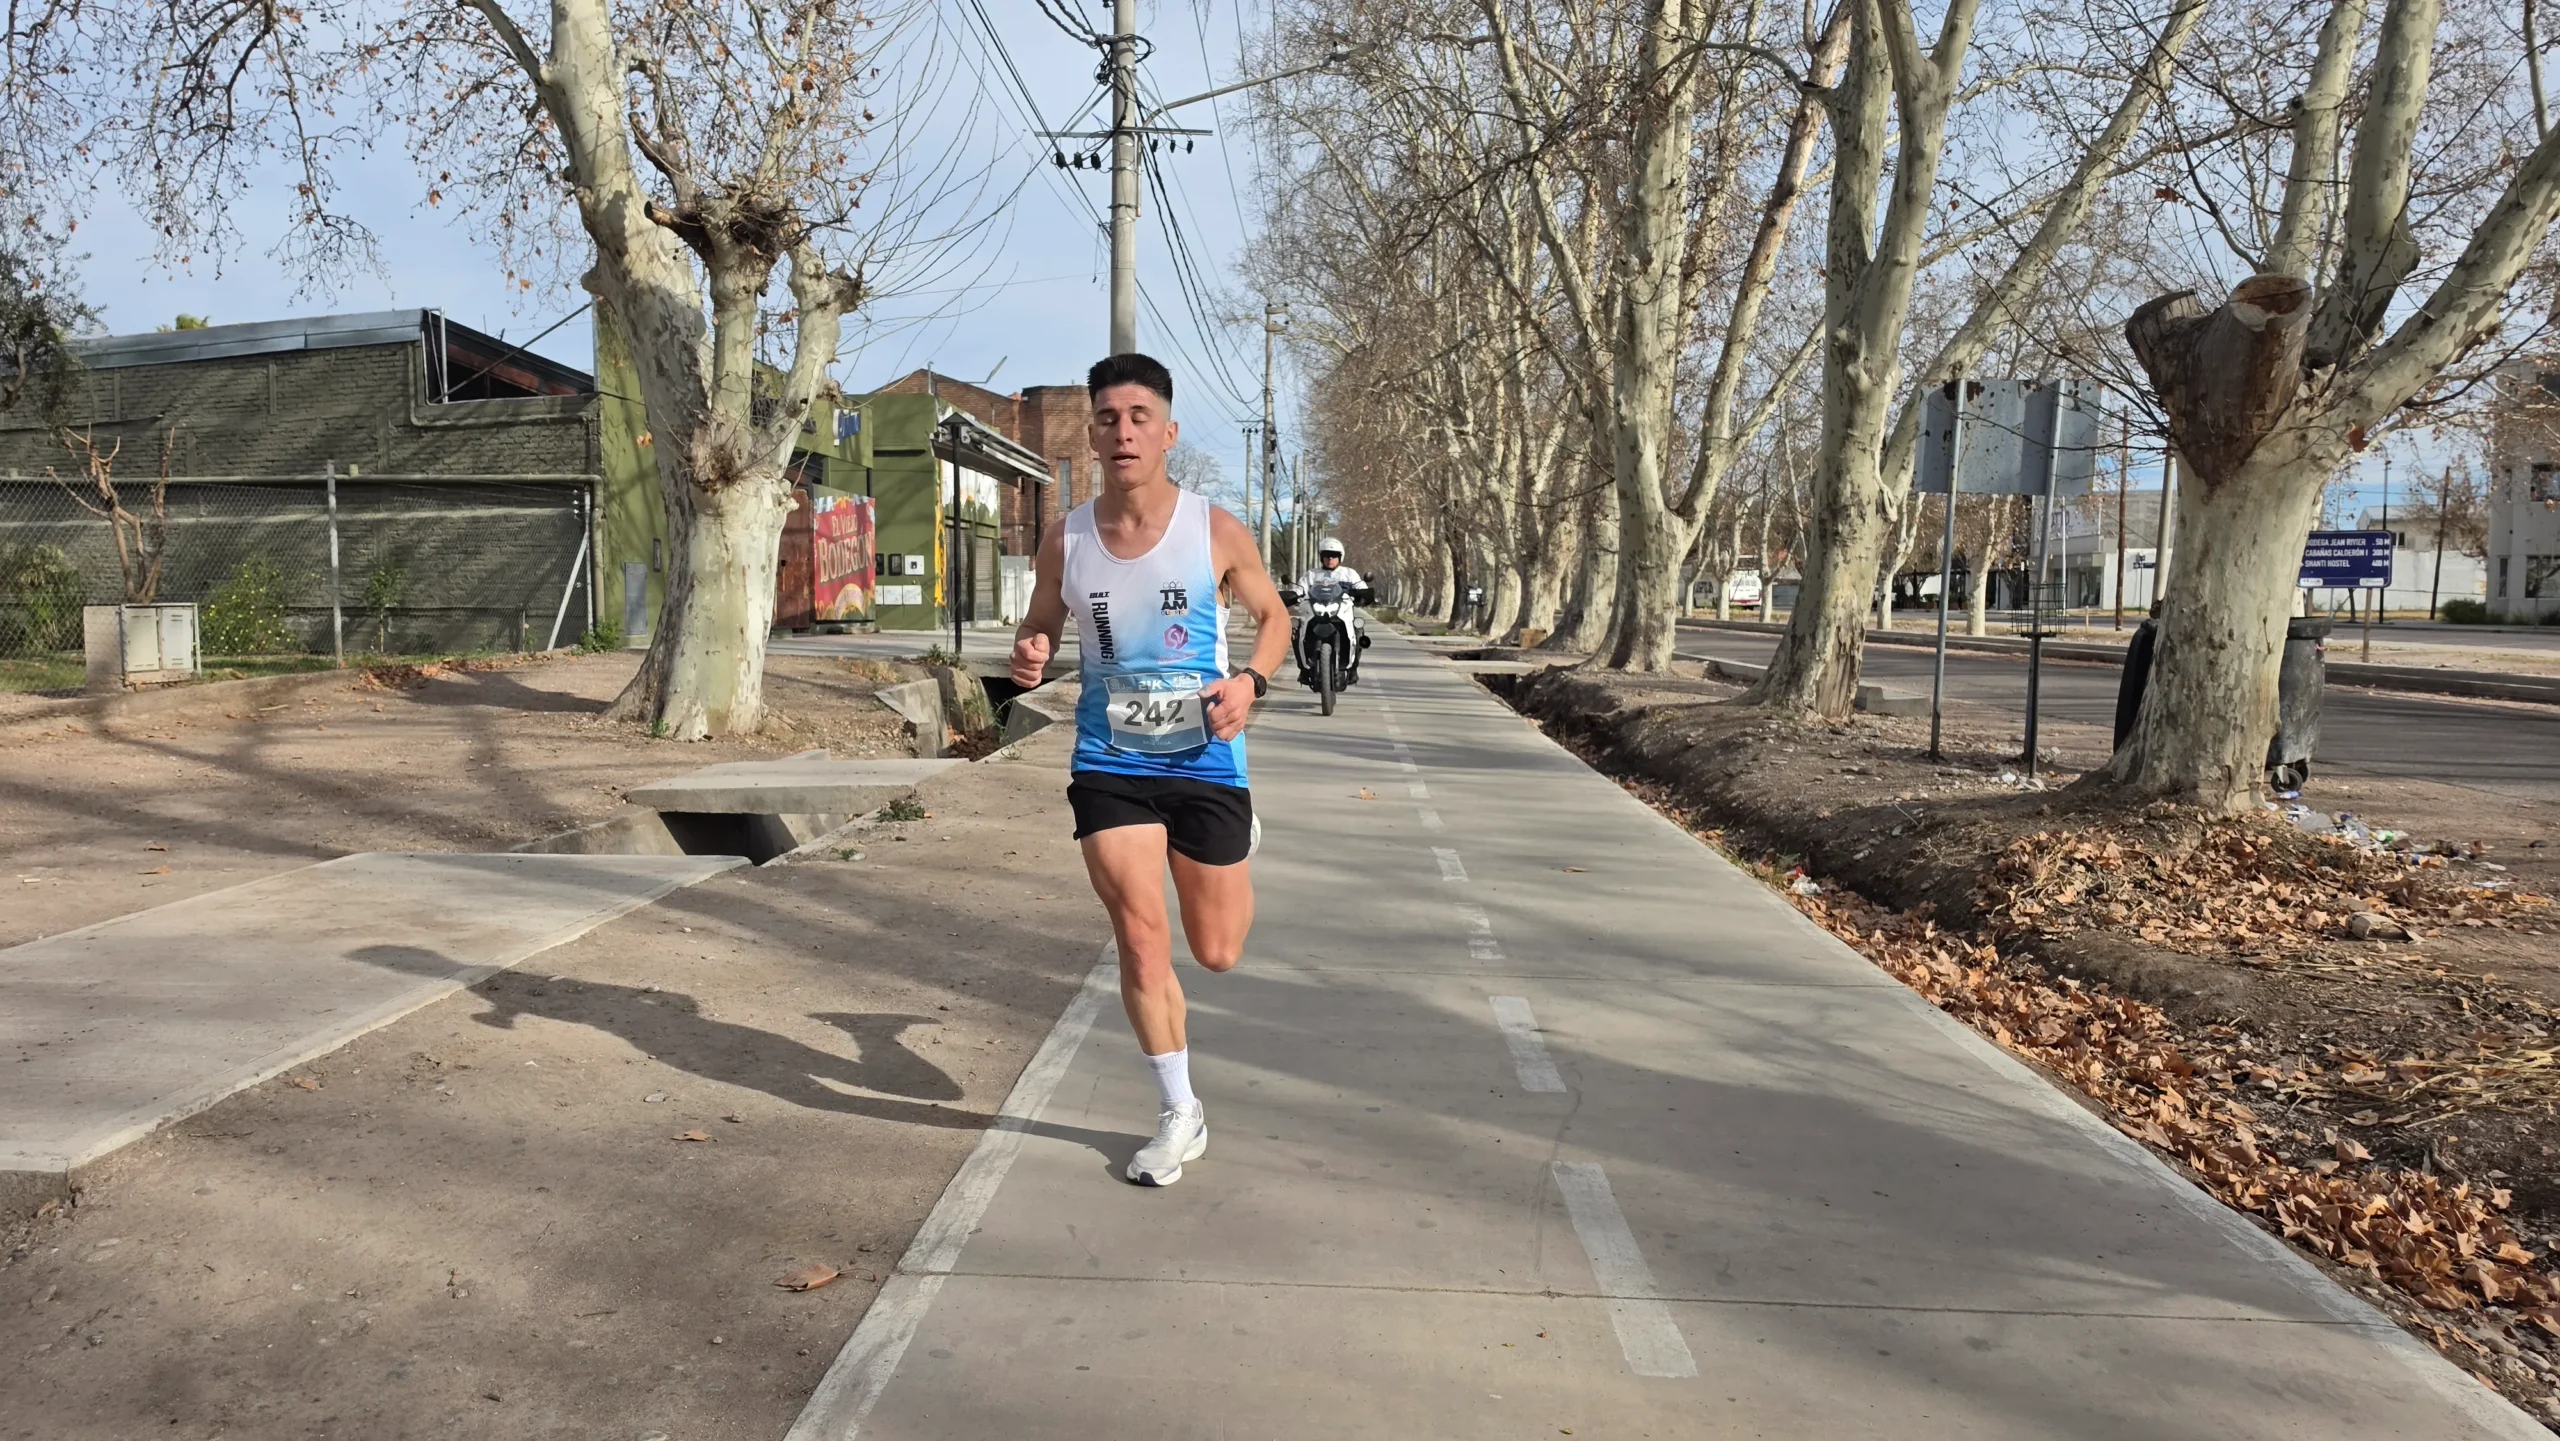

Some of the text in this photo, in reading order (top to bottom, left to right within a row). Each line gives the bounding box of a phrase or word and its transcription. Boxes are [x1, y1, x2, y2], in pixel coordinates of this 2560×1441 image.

[831, 513, 858, 537] EL VIEJO
[2330, 538, 2345, 546] JEAN
[2346, 538, 2366, 546] RIVIER
[2305, 548, 2332, 556] CABAÑAS
[2333, 547, 2364, 556] CALDERÓN
[1091, 602, 1115, 660] RUNNING
[1138, 679, 1163, 690] 21K
[1124, 699, 1185, 727] 242
